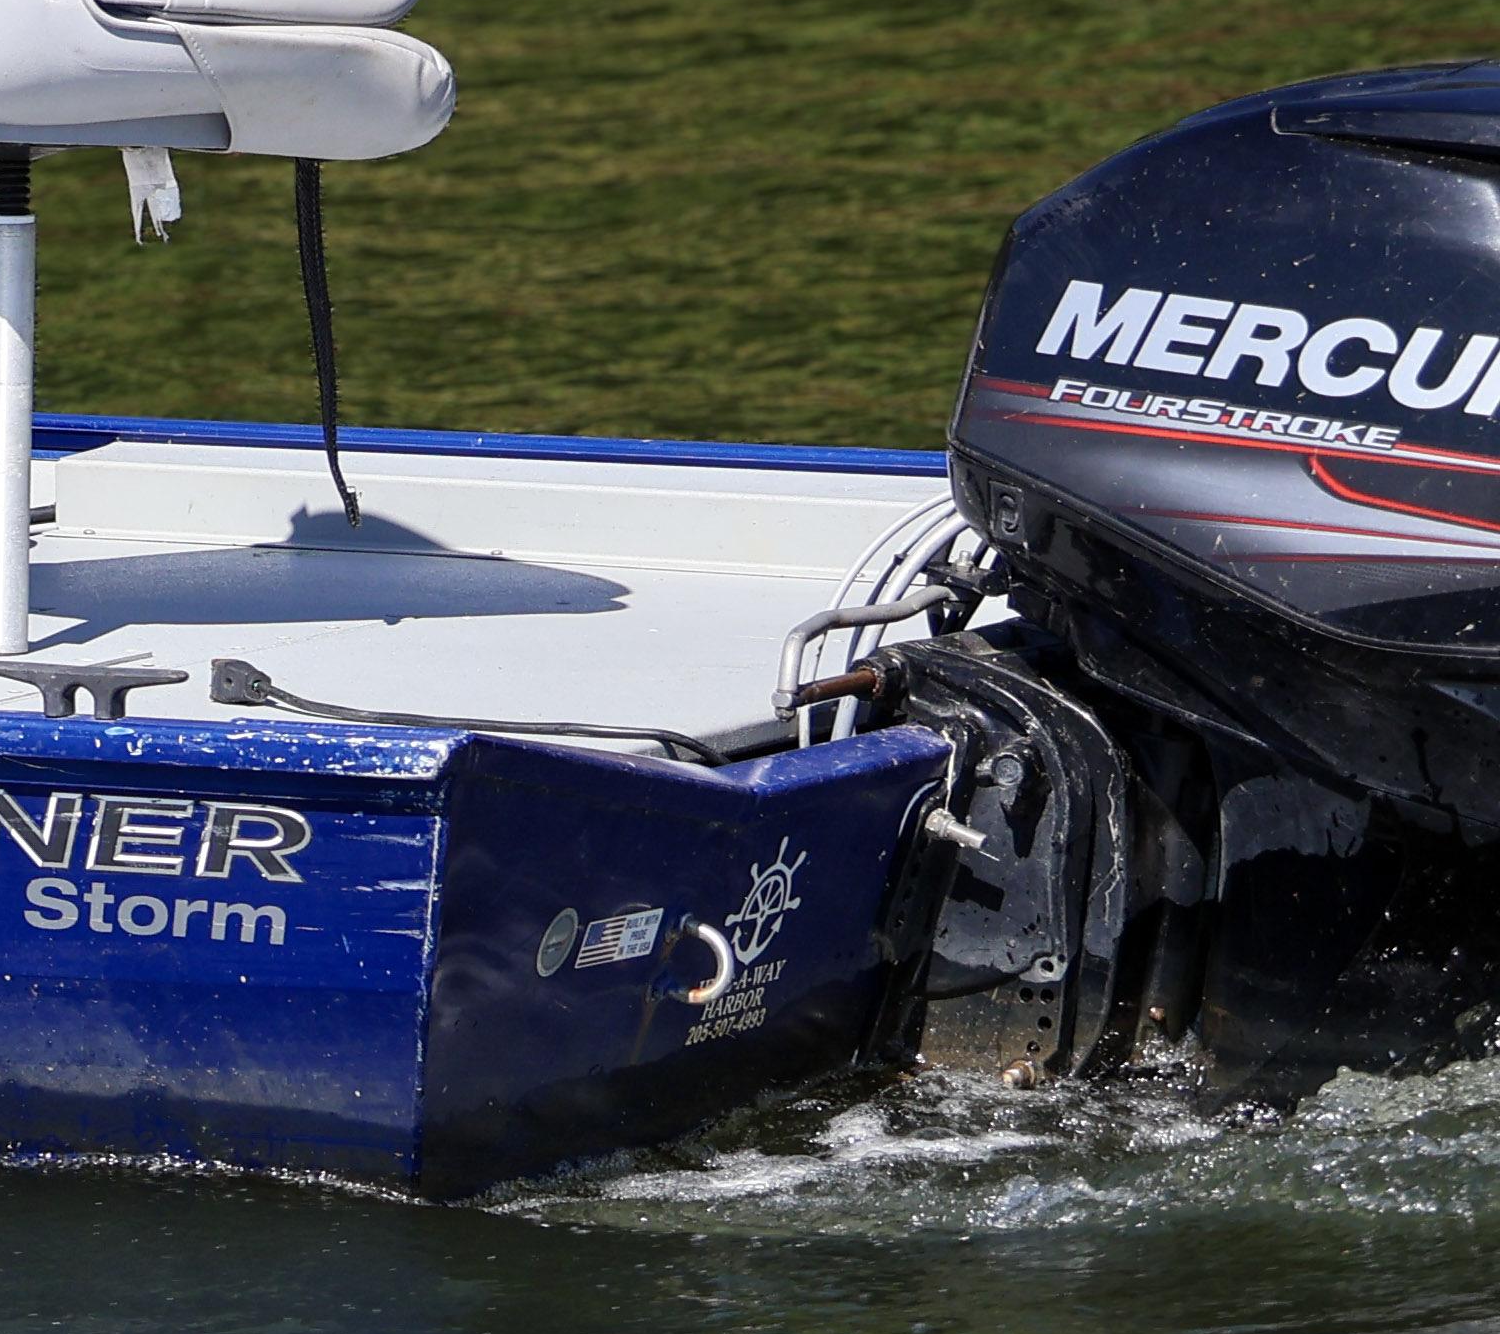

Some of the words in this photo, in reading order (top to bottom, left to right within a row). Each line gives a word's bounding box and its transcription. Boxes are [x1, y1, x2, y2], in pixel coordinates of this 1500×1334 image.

[1049, 378, 1400, 450] FOURSTROKE
[24, 878, 287, 945] Storm
[699, 959, 787, 993] -A-WAY
[701, 987, 765, 1021] HARBOR
[684, 1008, 767, 1046] 205-507-4993
